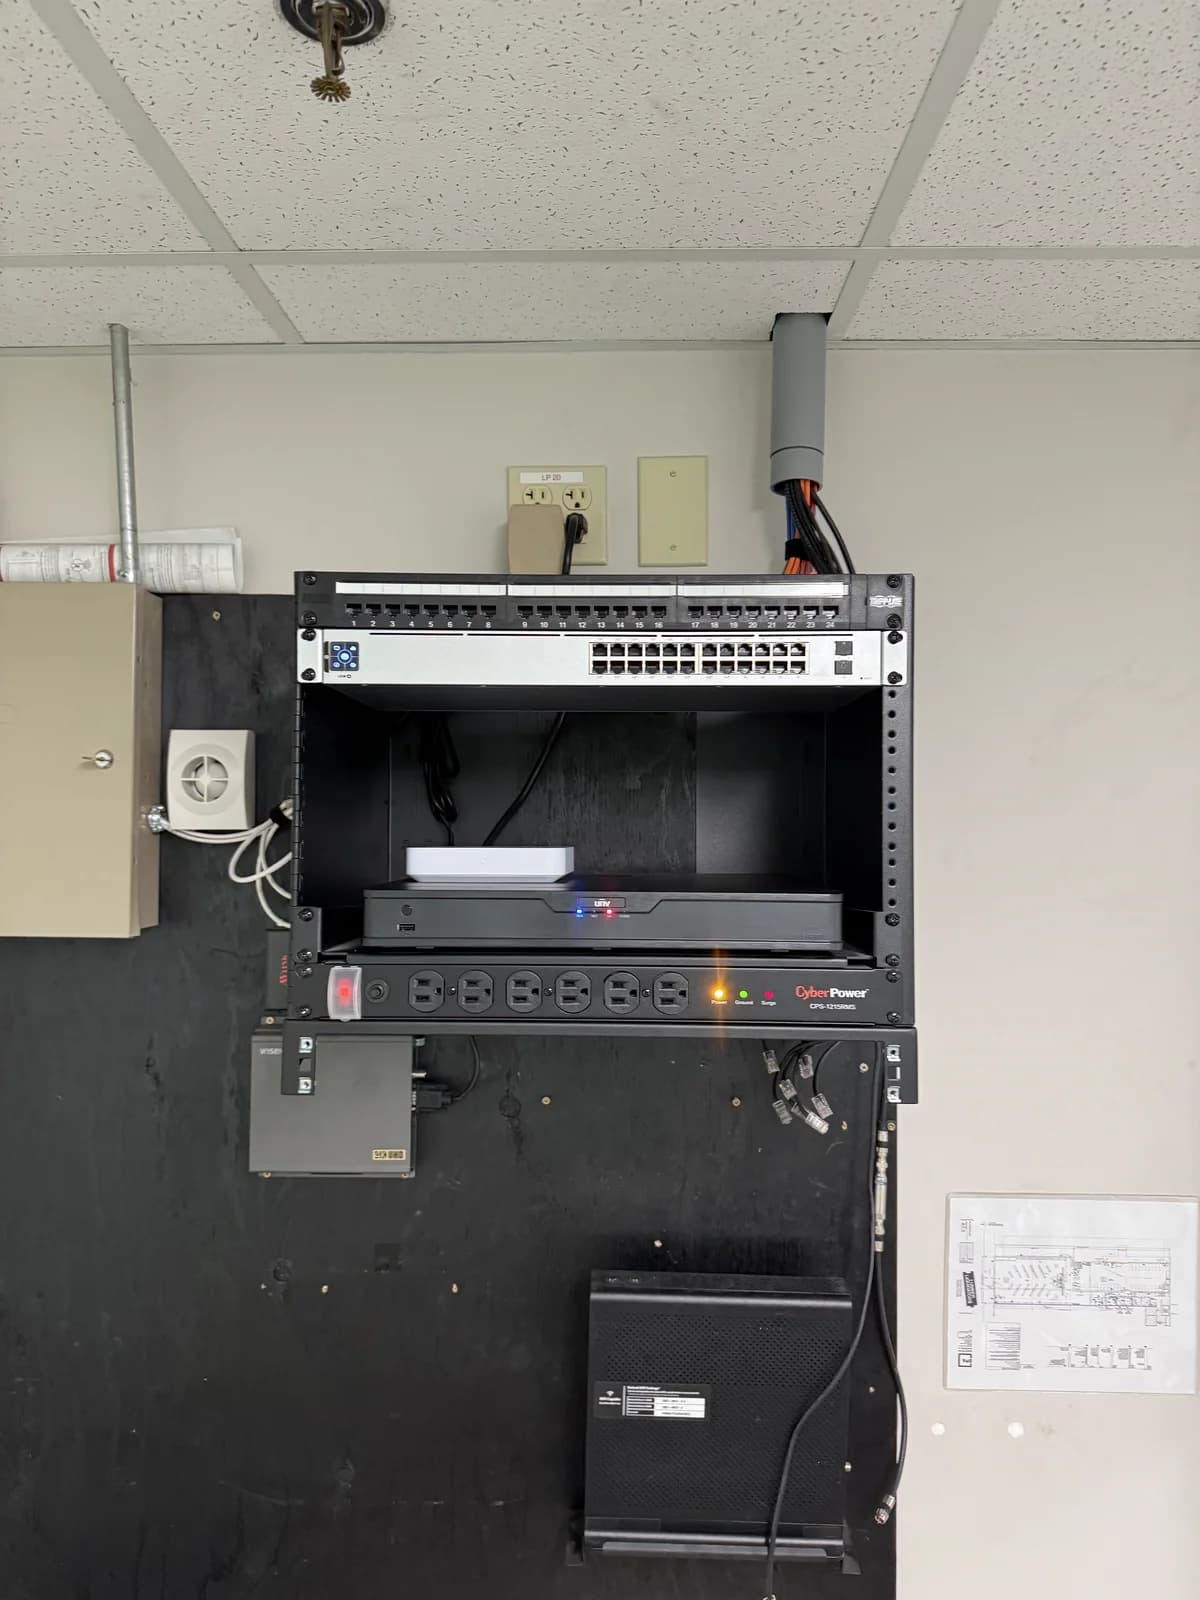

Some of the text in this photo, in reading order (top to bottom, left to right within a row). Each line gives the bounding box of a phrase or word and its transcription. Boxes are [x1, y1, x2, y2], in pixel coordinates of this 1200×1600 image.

[428, 620, 434, 628] 5
[447, 620, 453, 628] 6
[467, 620, 472, 628] 7
[486, 620, 491, 628] 8
[522, 621, 528, 629] 9
[540, 621, 549, 629] 10
[559, 621, 567, 629] 11
[578, 621, 587, 629] 12
[597, 621, 606, 629] 13
[616, 621, 625, 629] 14
[635, 621, 644, 629] 15
[654, 621, 663, 629] 16
[691, 621, 700, 629] 17
[710, 621, 719, 629] 18
[729, 621, 739, 629] 19
[747, 621, 758, 629] 20
[767, 621, 776, 629] 21
[786, 621, 796, 629] 22
[806, 621, 816, 629] 23
[825, 621, 835, 629] 24
[795, 985, 869, 1000] CyberPower
